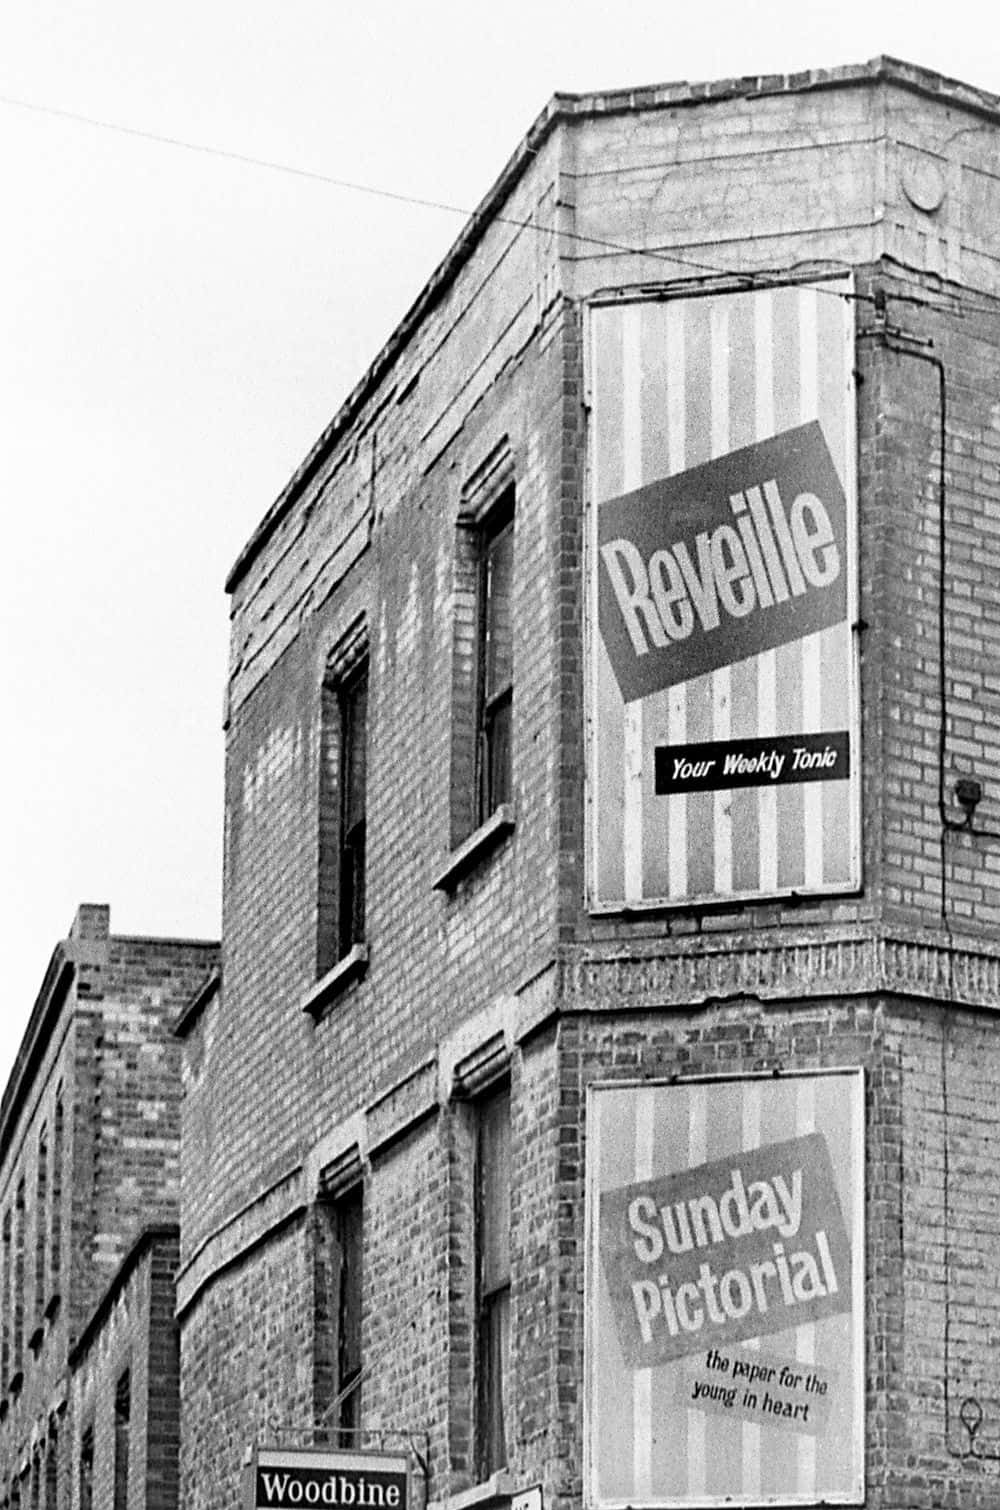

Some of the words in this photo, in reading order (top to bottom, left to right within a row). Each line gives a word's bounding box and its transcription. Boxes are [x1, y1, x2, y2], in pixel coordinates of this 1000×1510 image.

[601, 479, 841, 656] Reveille
[672, 756, 715, 780] Your
[722, 748, 785, 775] Weekly
[792, 744, 837, 769] Tonic
[627, 1170, 803, 1264] Sunday
[631, 1230, 839, 1344] Pictorial
[706, 1350, 730, 1373] the
[732, 1361, 776, 1383] paper
[779, 1366, 802, 1389] for
[805, 1374, 828, 1395] the
[691, 1381, 738, 1408] young
[743, 1388, 758, 1409] in
[762, 1393, 809, 1421] heart
[261, 1472, 400, 1506] Woodbine
